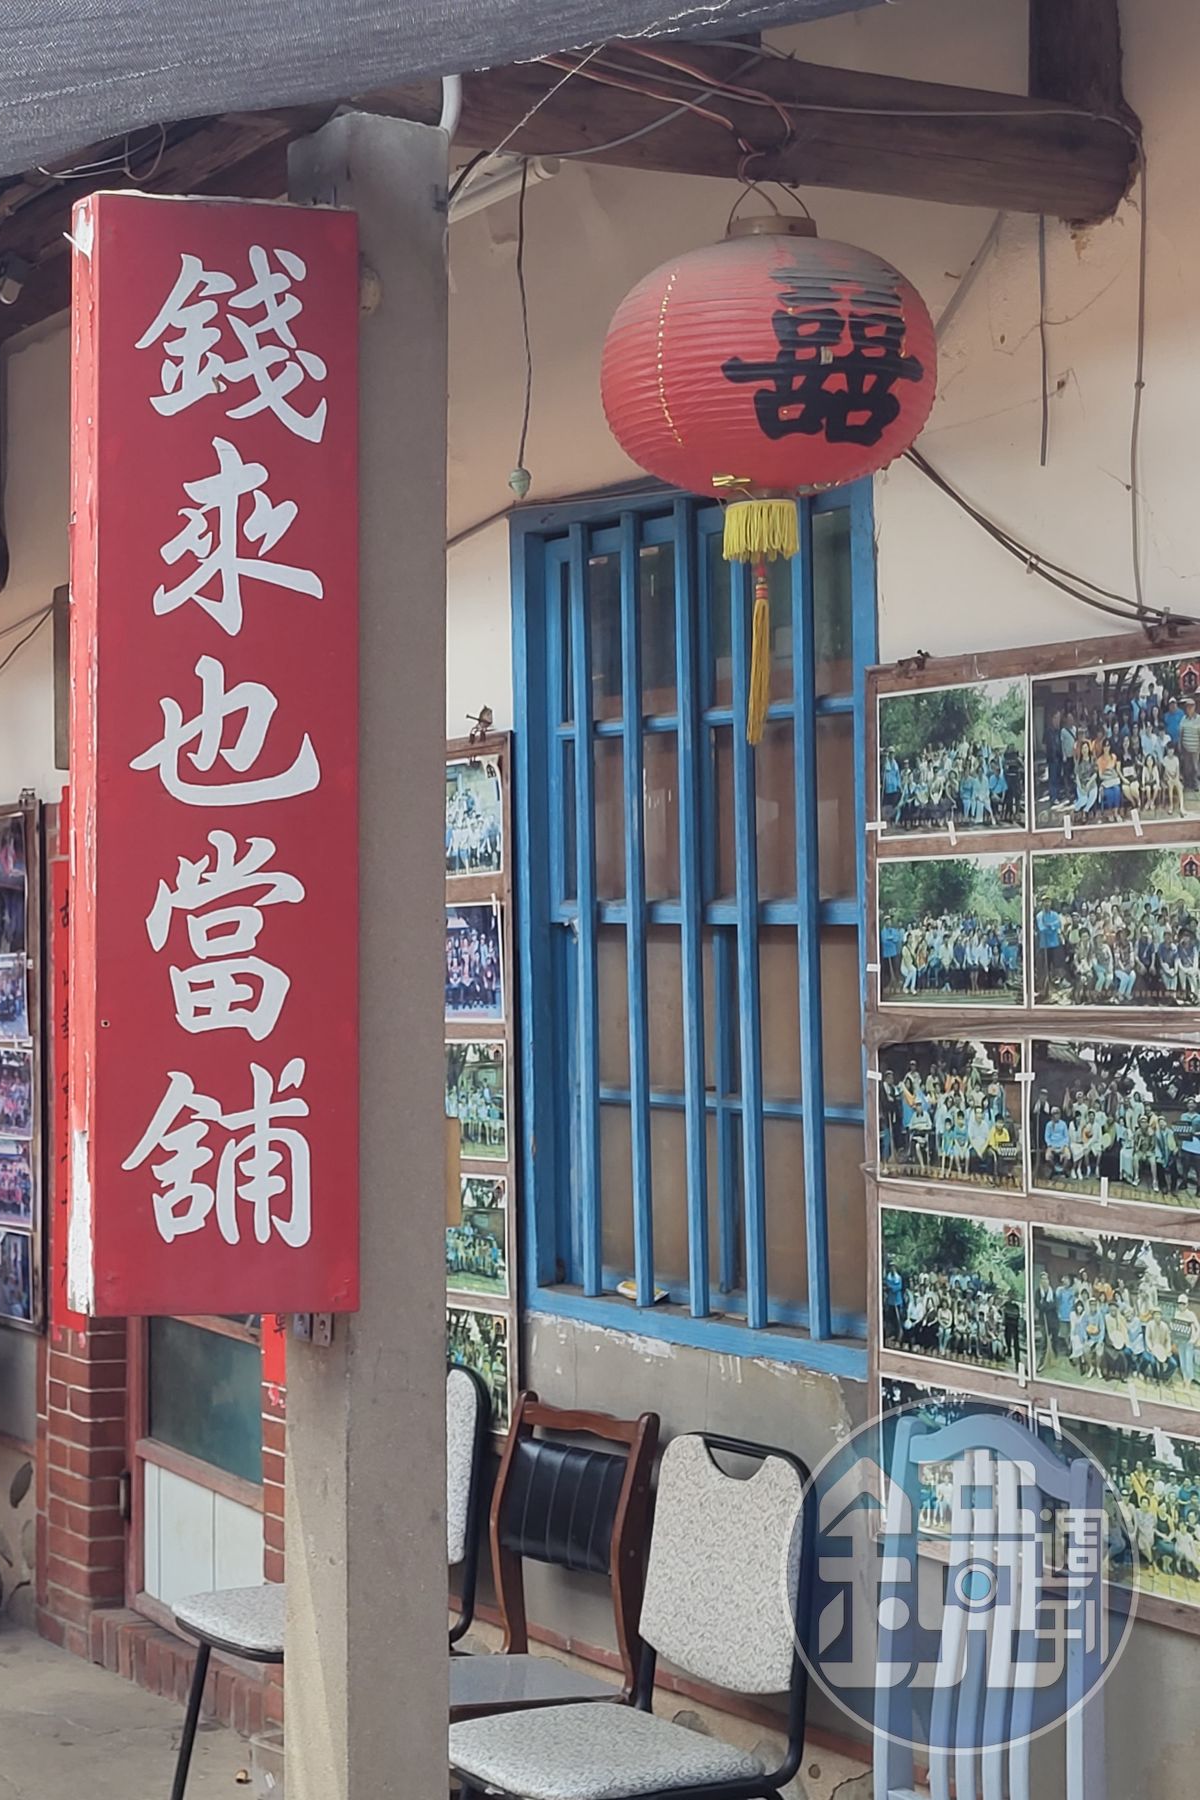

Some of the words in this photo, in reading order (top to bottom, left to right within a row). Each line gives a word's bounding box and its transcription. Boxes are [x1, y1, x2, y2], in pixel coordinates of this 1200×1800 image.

[120, 244, 328, 1250] 錢來也當舖
